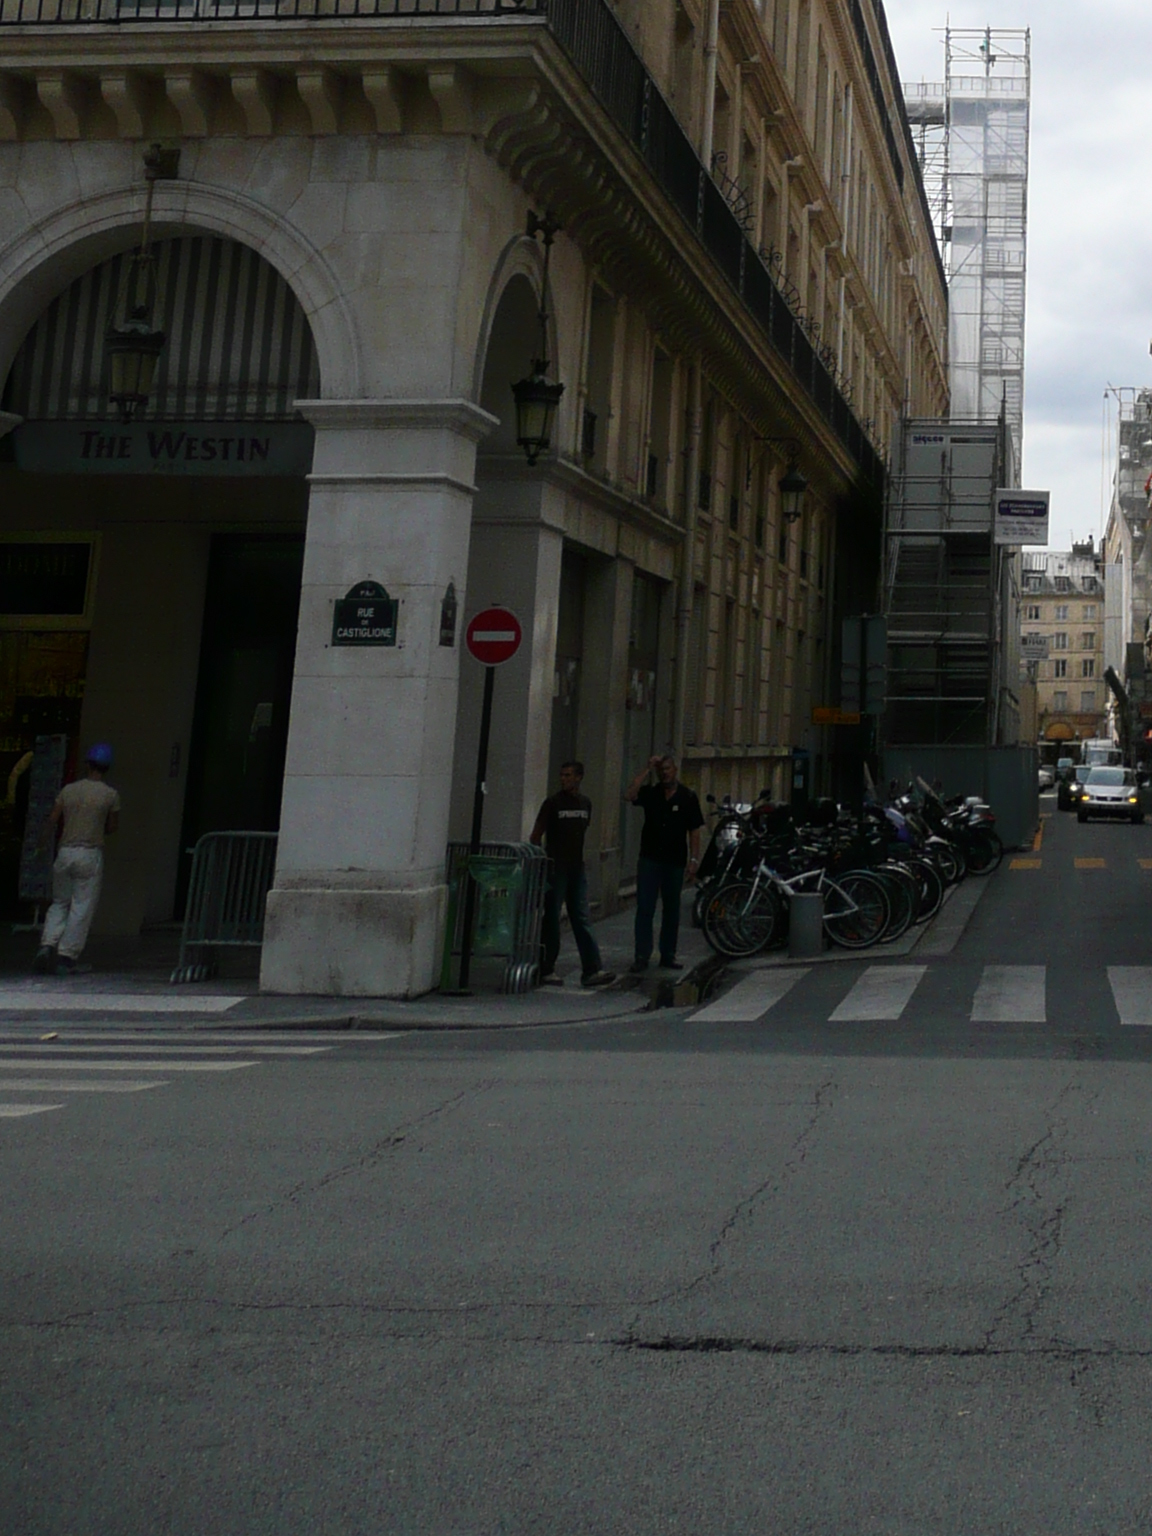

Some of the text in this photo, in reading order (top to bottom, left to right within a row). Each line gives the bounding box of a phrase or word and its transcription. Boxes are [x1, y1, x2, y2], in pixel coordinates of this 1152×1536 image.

[79, 430, 270, 461] THE WESTIN
[357, 607, 375, 618] RUE
[337, 627, 393, 638] CASTIGLIONE
